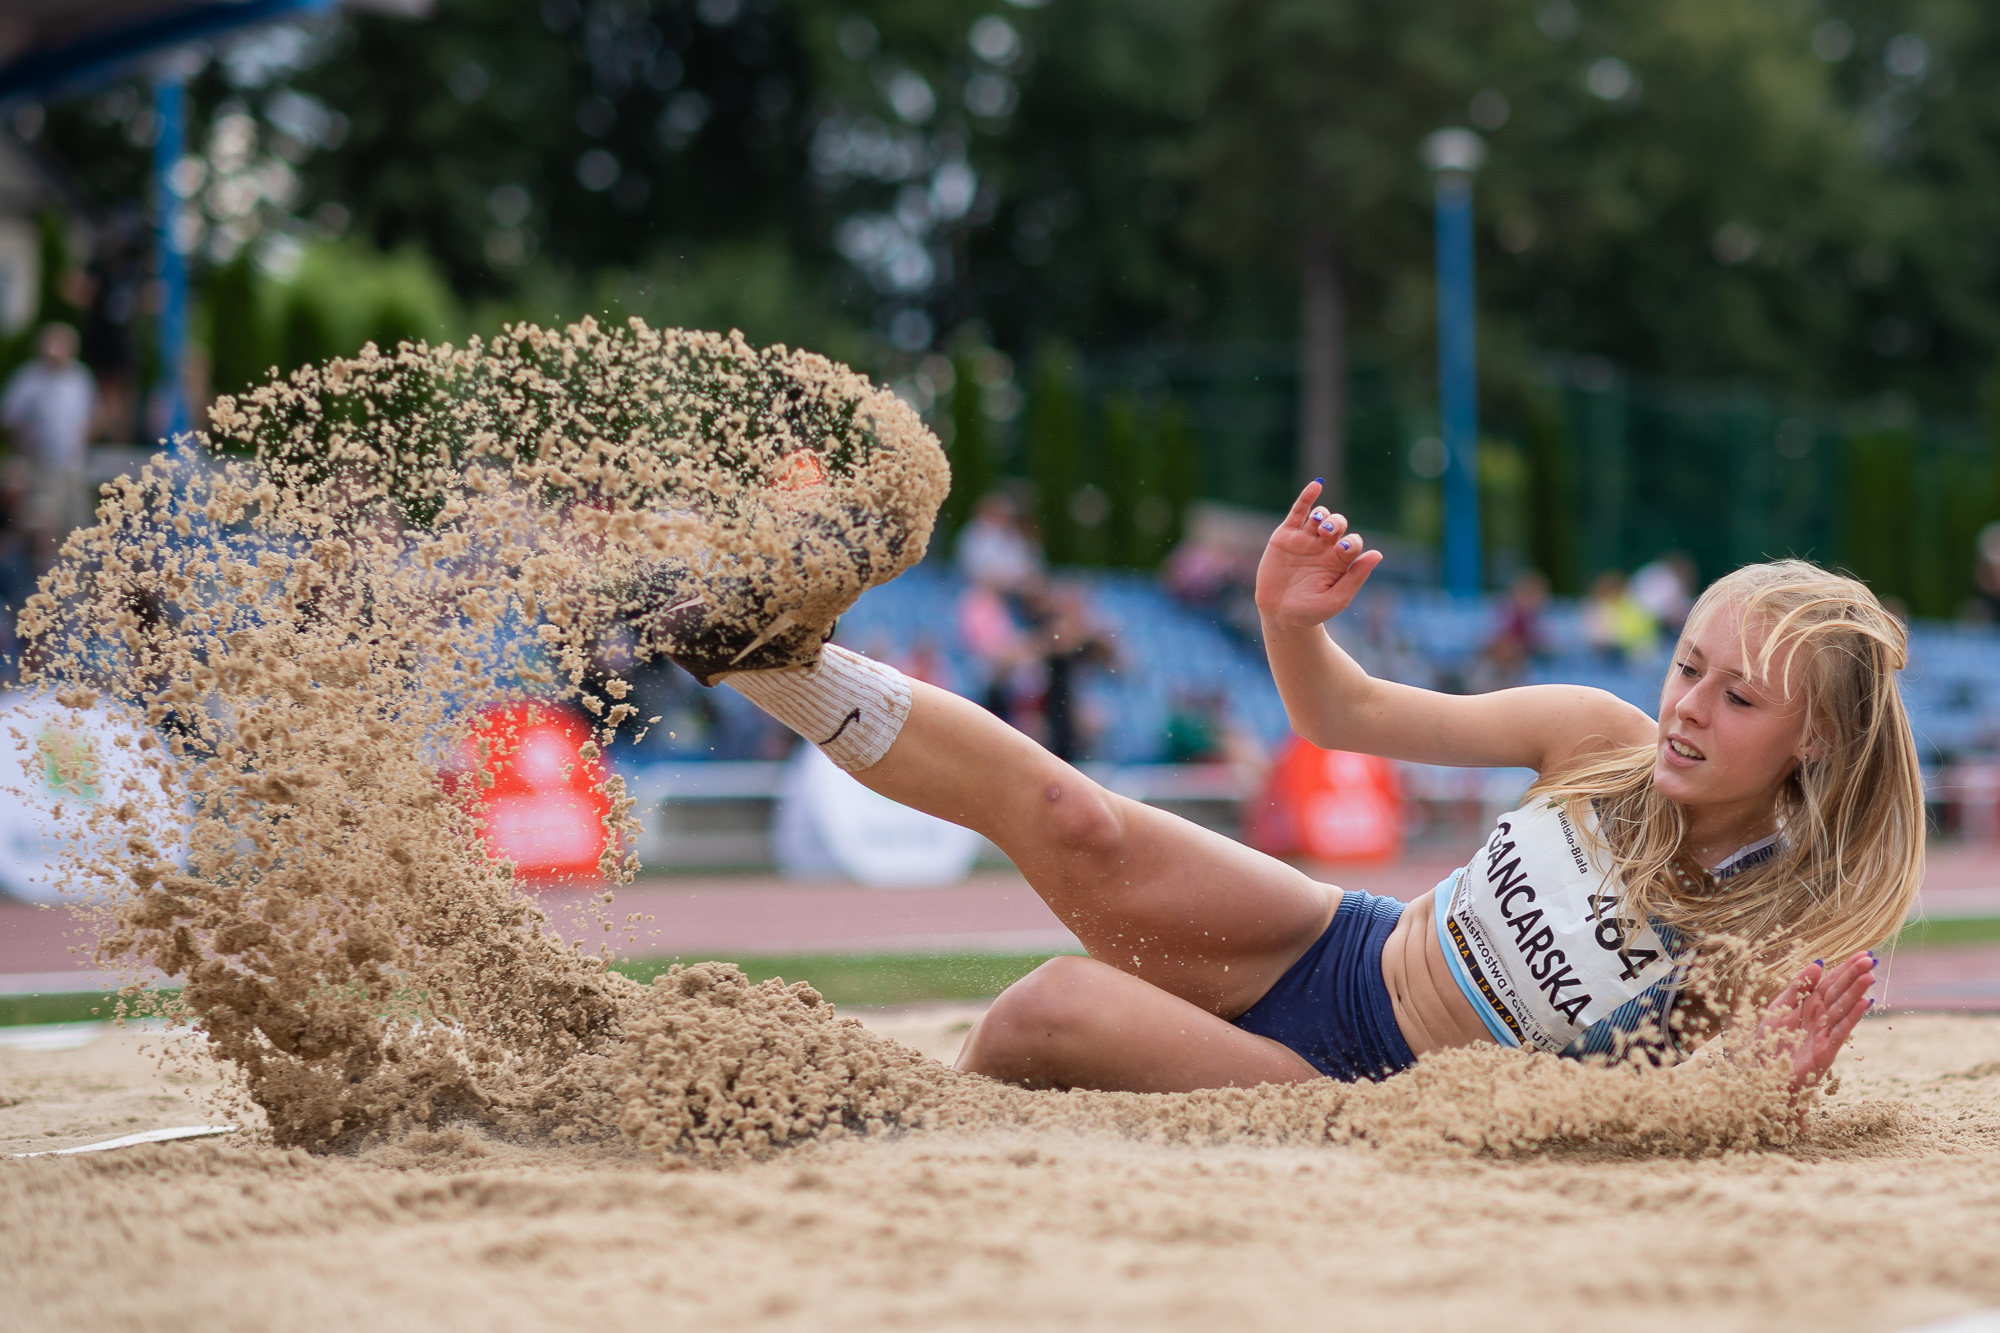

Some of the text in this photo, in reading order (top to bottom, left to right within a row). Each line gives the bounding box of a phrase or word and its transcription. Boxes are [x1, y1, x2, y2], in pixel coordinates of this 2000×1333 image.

[1557, 810, 1588, 875] Bielsko-Biała
[1458, 909, 1508, 990] Mistrzostwa
[1505, 988, 1532, 1032] Polski
[1486, 821, 1592, 1026] GANCARSKA
[1584, 894, 1660, 982] 464
